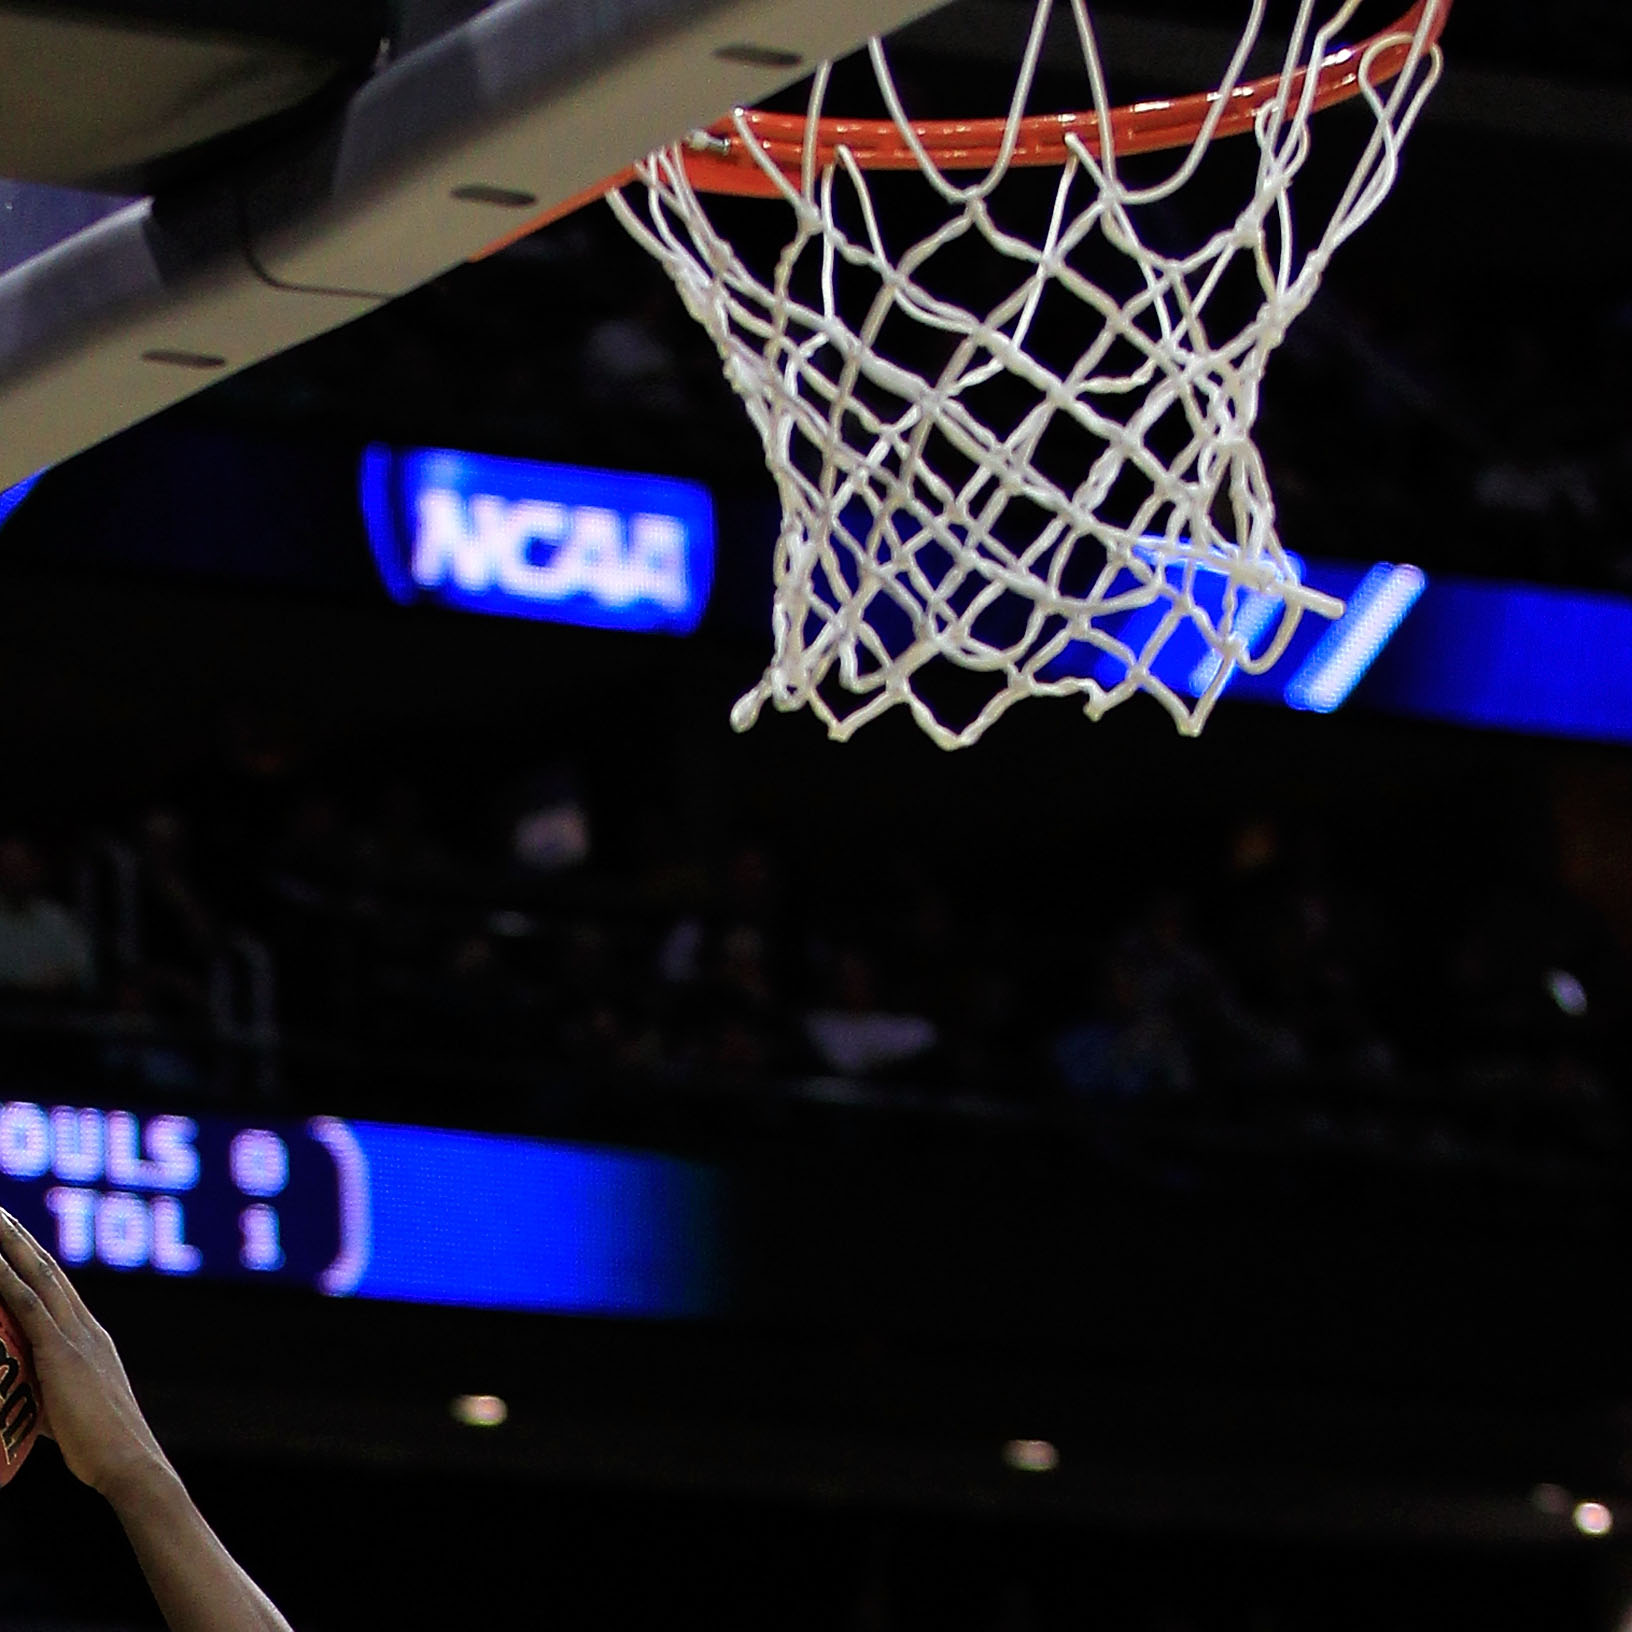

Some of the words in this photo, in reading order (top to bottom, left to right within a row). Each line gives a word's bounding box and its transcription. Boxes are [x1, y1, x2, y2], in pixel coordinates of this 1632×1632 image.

[414, 488, 688, 612] NCAA
[44, 1186, 203, 1276] TOL
[238, 1202, 286, 1272] 1
